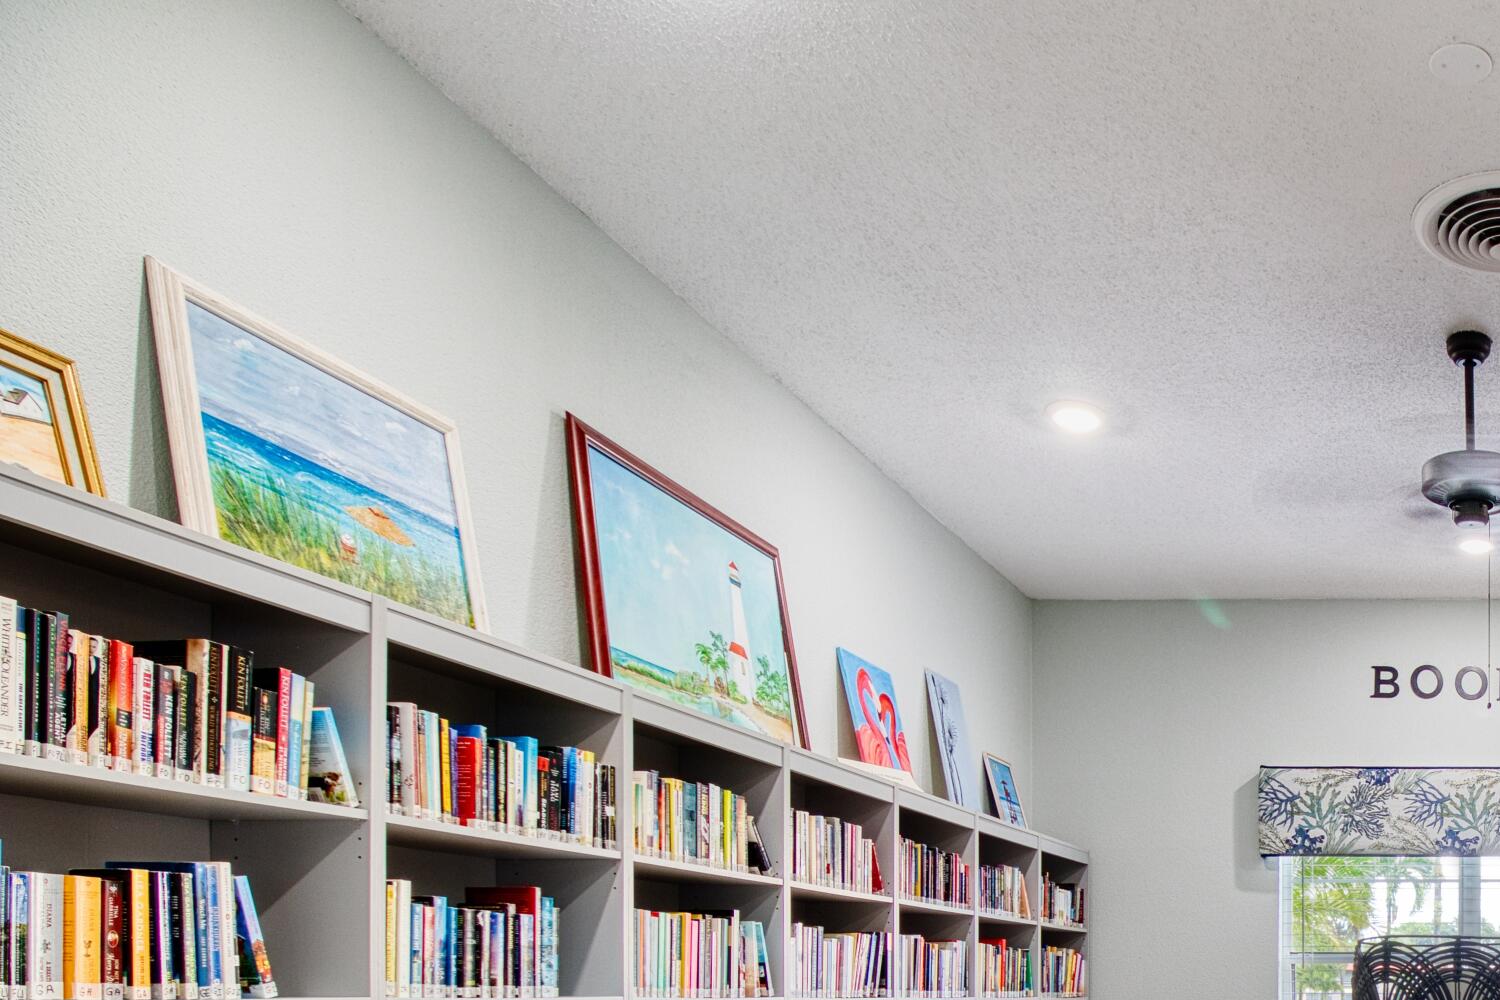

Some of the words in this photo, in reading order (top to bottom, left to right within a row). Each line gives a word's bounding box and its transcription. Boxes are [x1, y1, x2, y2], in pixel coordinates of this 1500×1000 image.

[236, 655, 246, 675] KEN
[180, 673, 188, 692] KEN
[280, 675, 290, 694] KEN
[235, 675, 246, 711] FOLLETT
[164, 694, 172, 714] KEN
[180, 693, 188, 727] FOLLETT
[280, 694, 289, 729] FOLLETT
[164, 716, 172, 758] FOLLETT
[37, 984, 55, 996] GA
[105, 987, 121, 996] GA
